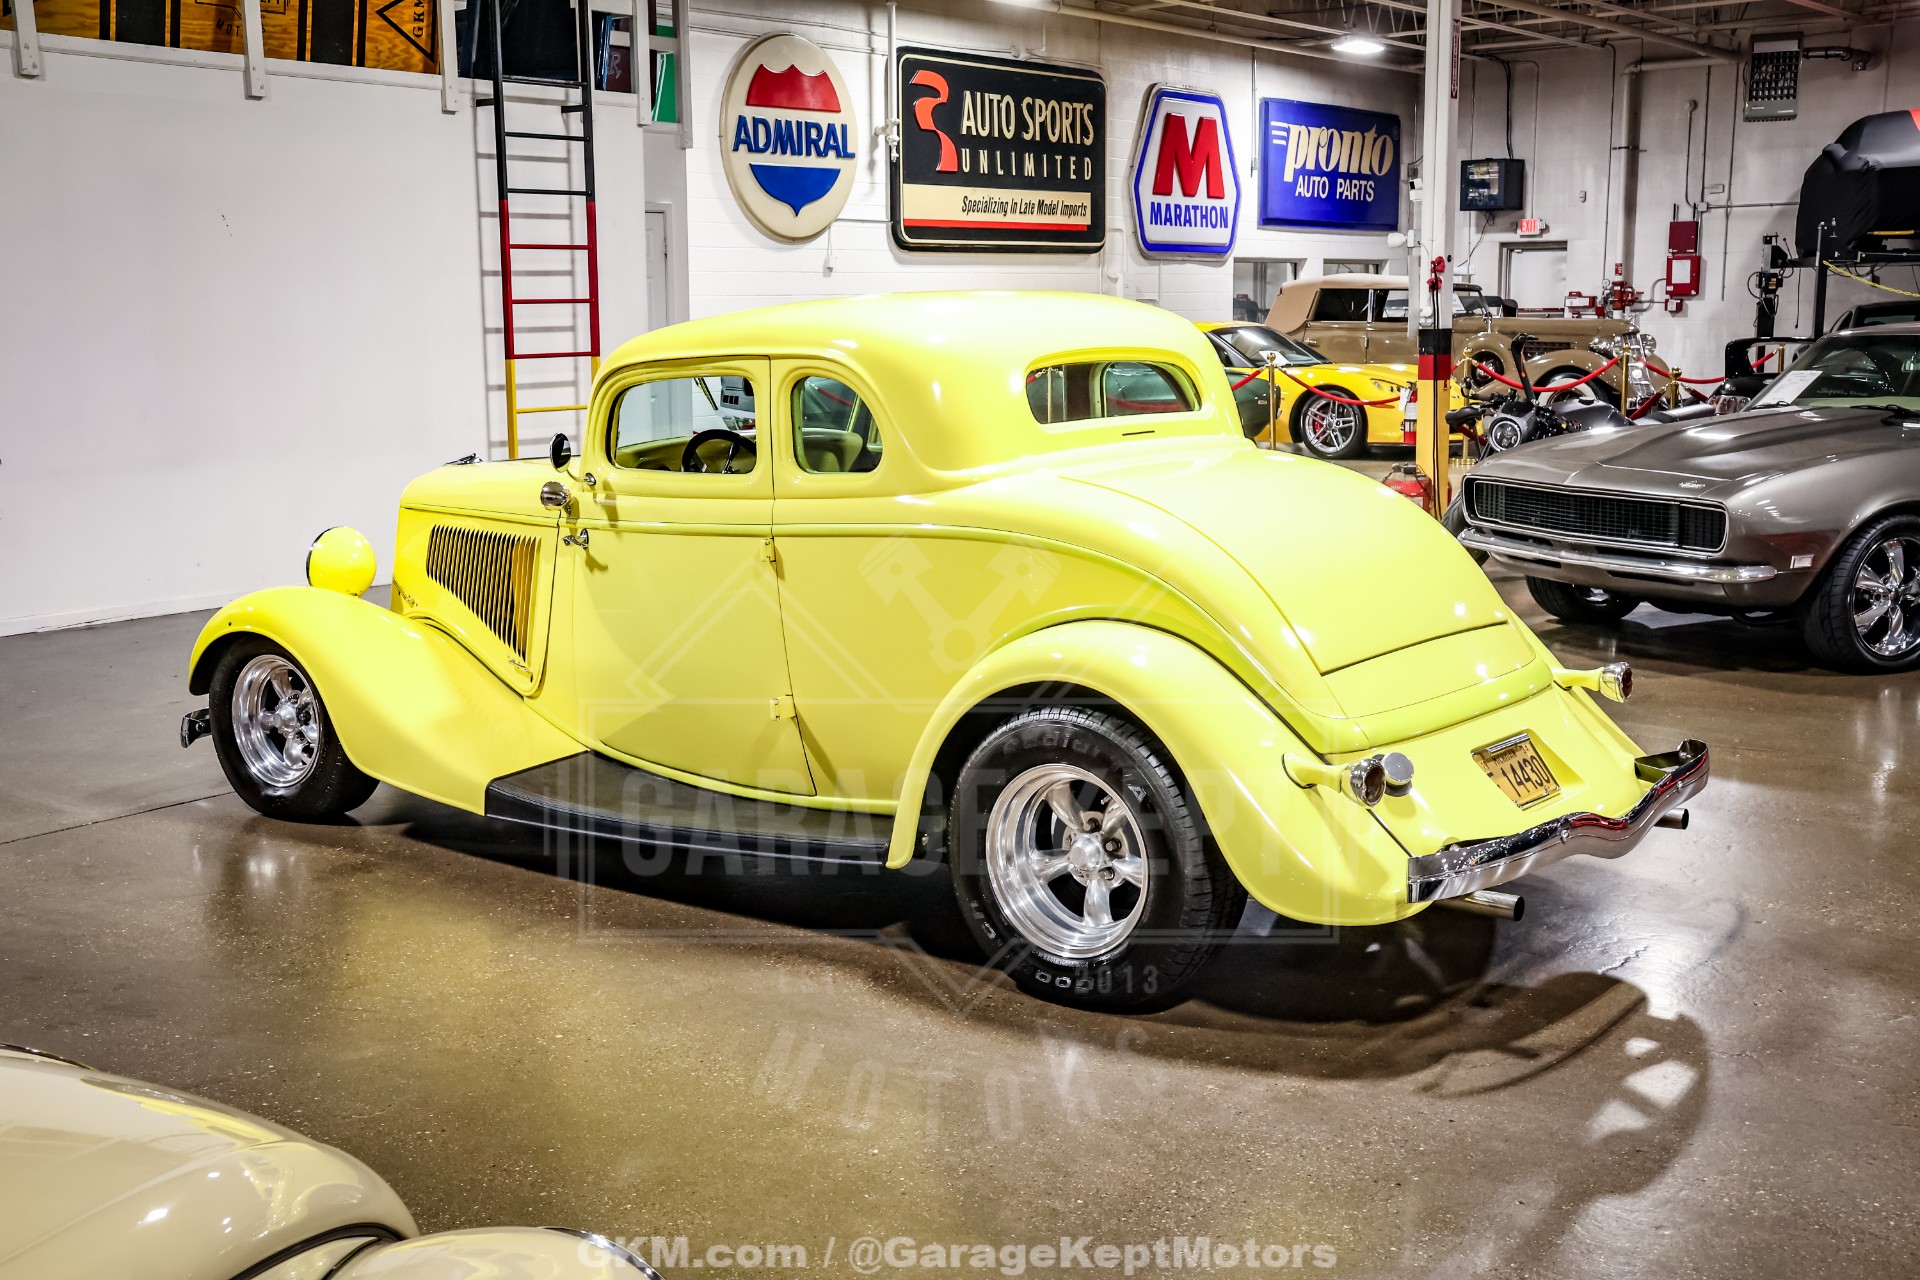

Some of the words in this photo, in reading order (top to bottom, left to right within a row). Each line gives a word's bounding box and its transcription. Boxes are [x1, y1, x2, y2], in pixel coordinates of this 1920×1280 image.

[732, 114, 856, 158] ADMIRAL
[960, 90, 1016, 140] AUTO
[1021, 96, 1094, 146] SPORTS
[960, 148, 1092, 181] UNLIMITED
[1152, 112, 1225, 199] M
[1283, 123, 1394, 182] pronto
[962, 195, 1008, 218] Specializing
[1019, 198, 1035, 215] Late
[1036, 199, 1059, 216] Model
[1060, 200, 1088, 219] Imports
[1295, 175, 1329, 199] AUTO
[1336, 178, 1375, 202] PARTS
[1150, 201, 1229, 229] MARATHON
[1520, 218, 1538, 233] EXIT
[1500, 754, 1551, 798] 14430
